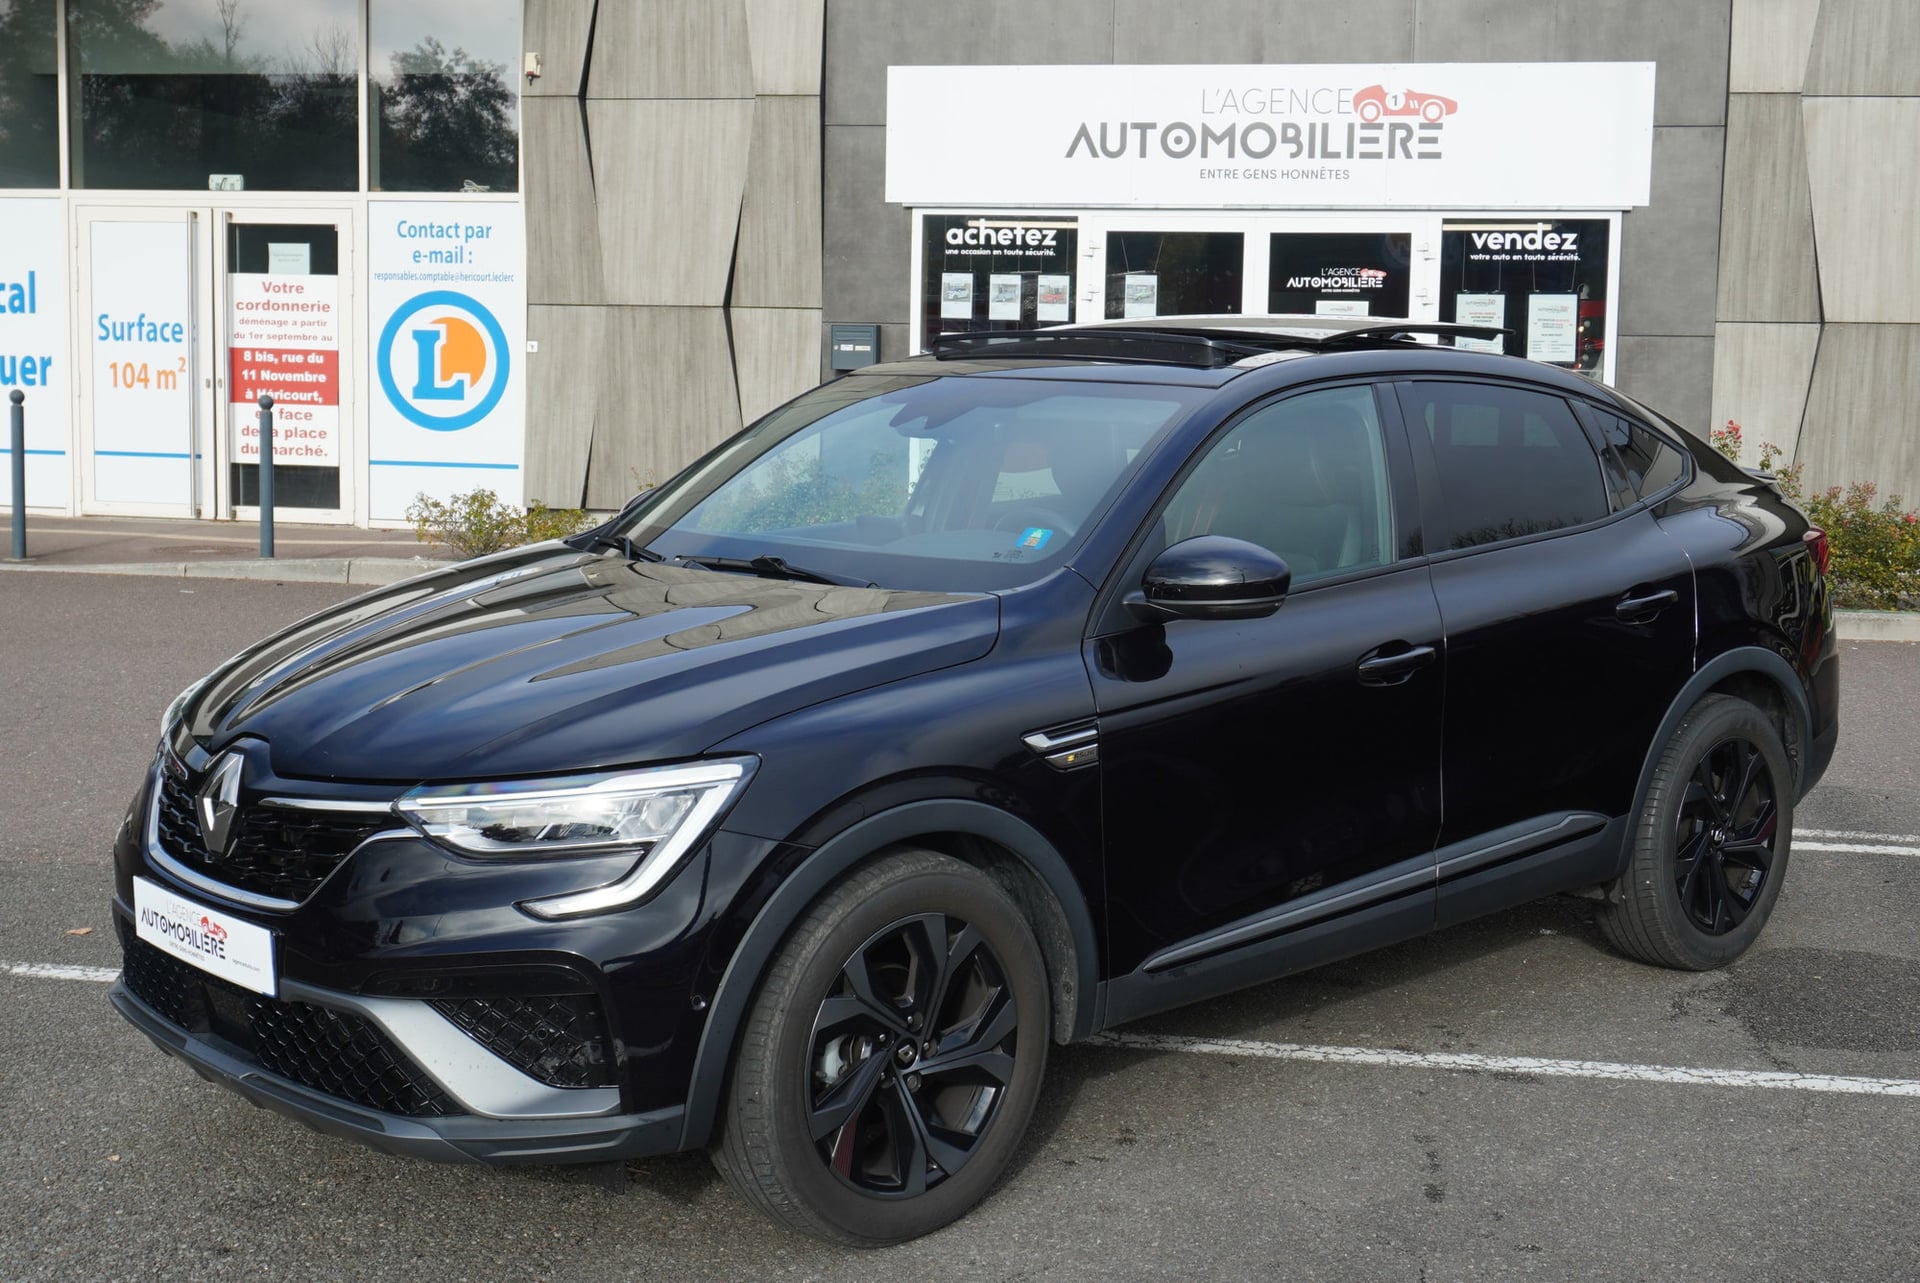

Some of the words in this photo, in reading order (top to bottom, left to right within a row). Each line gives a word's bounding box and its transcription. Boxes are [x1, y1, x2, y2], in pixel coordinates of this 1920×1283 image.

[1201, 88, 1353, 114] L'AGENCE
[1200, 169, 1239, 180] ENTRE
[1243, 169, 1278, 180] GENS
[1281, 166, 1350, 180] HONNÊTES
[397, 220, 460, 238] Contact
[465, 225, 492, 243] par
[946, 218, 1057, 246] achetez
[1471, 222, 1578, 250] vendez
[412, 245, 464, 263] e-mail
[1025, 248, 1056, 256] sécurité.
[1321, 268, 1360, 276] L'AGENCE
[262, 282, 304, 294] Votre
[236, 300, 331, 312] cordonnerie
[98, 313, 184, 342] Surface
[300, 318, 328, 328] partir
[266, 332, 318, 341] septembre
[243, 350, 252, 362] 8
[255, 351, 278, 364] bis,
[282, 353, 304, 363] rue
[307, 352, 324, 364] du
[109, 362, 150, 389] 104
[242, 369, 256, 380] 11
[260, 370, 327, 382] Novembre
[245, 388, 254, 400] à
[279, 408, 313, 420] face
[241, 426, 260, 437] de
[284, 426, 327, 440] place
[240, 443, 258, 454] du
[272, 444, 328, 456] arché.
